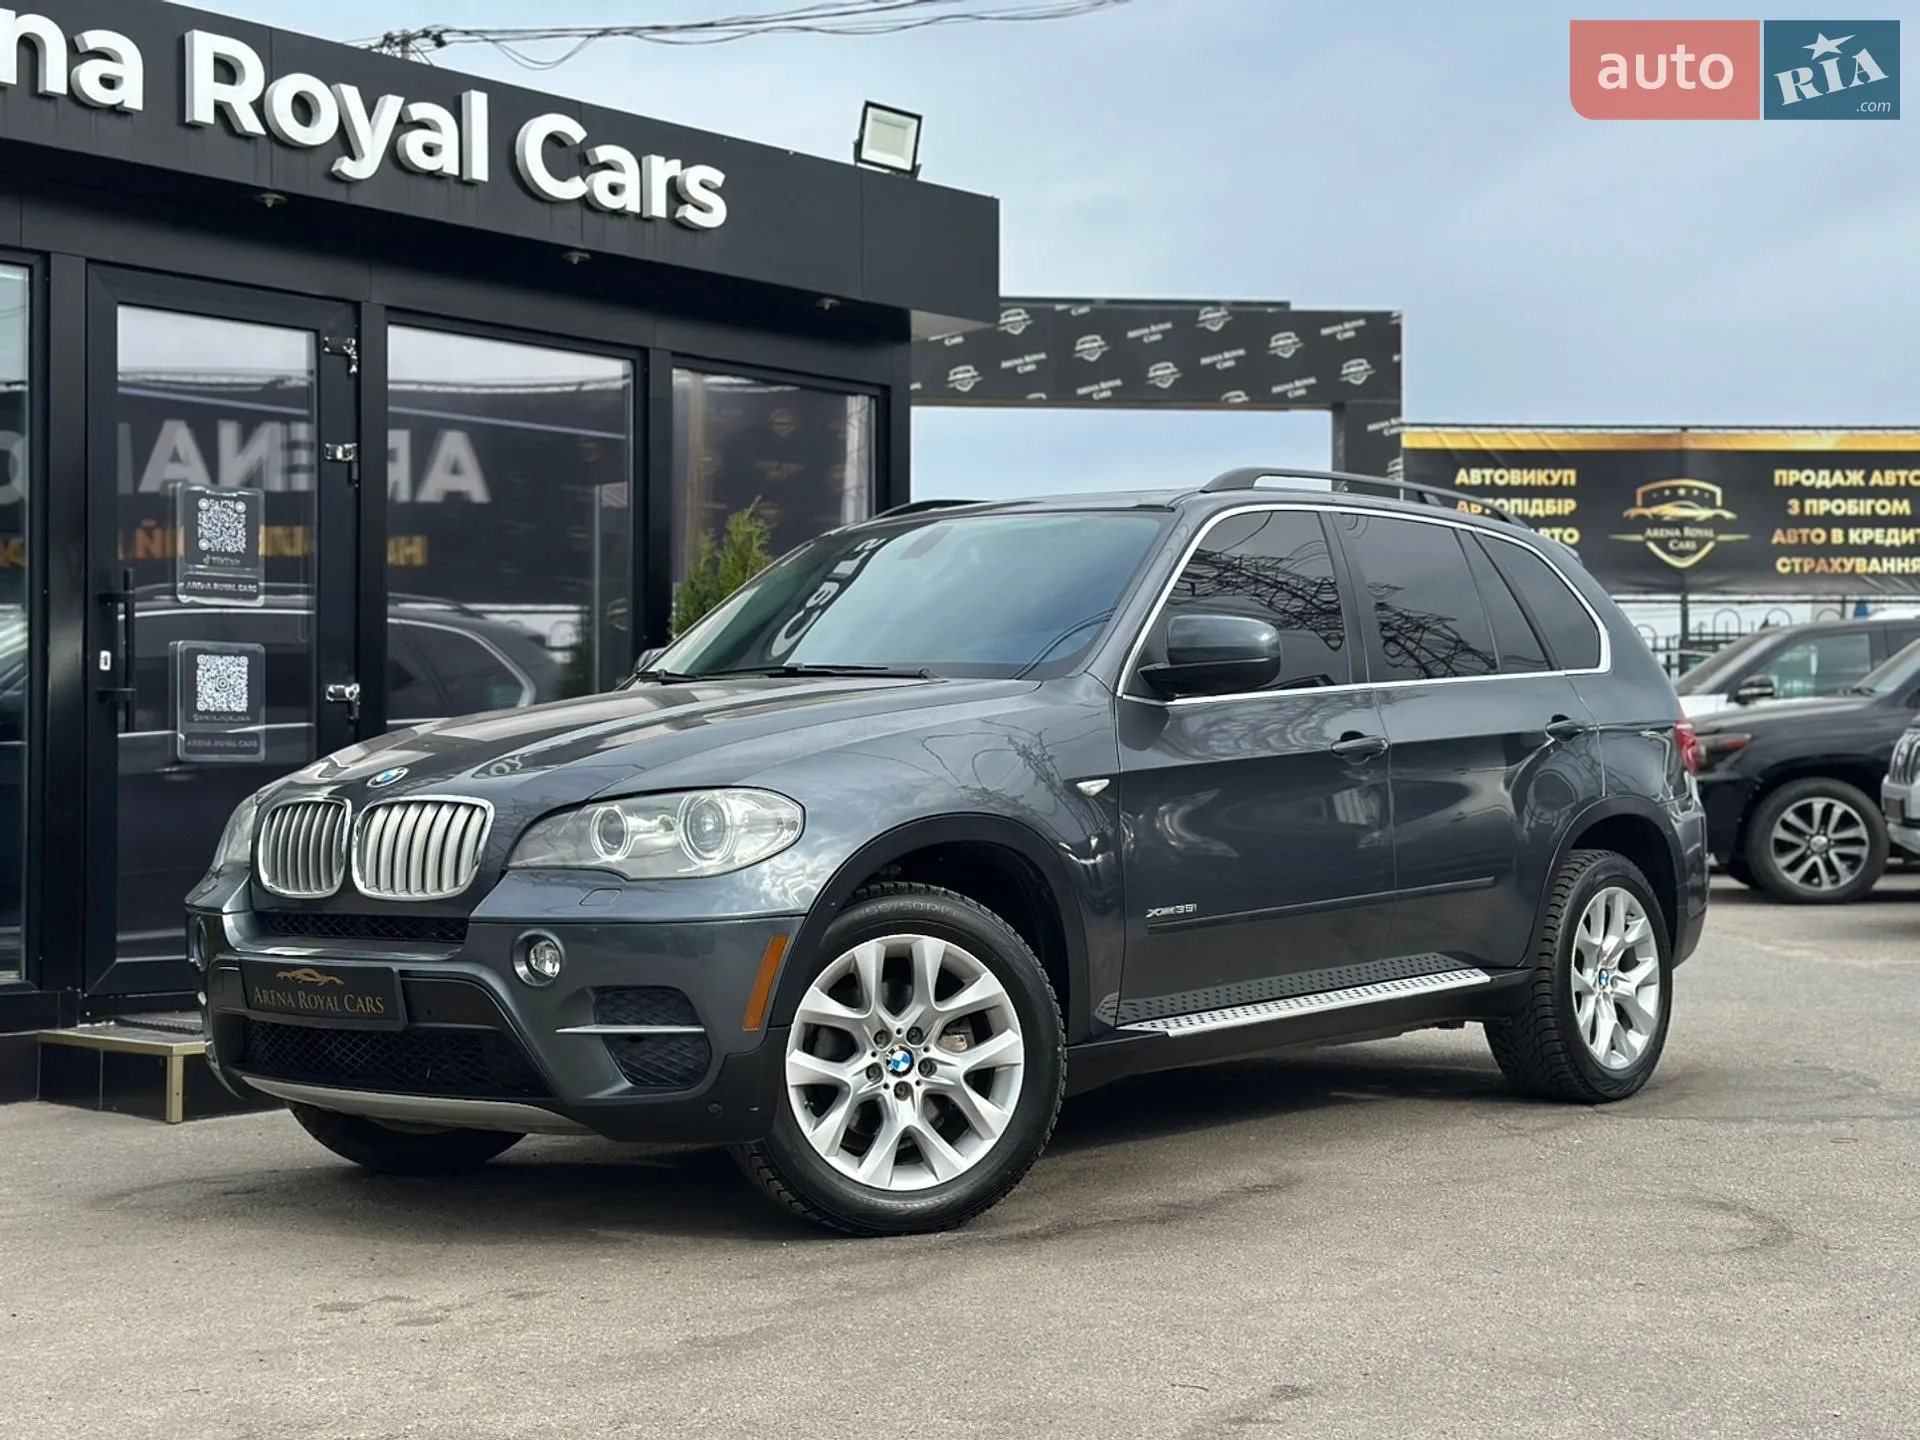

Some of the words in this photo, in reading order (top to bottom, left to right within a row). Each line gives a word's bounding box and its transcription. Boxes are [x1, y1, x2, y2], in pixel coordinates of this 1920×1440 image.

[184, 28, 491, 184] Royal
[515, 112, 728, 230] Cars
[1454, 467, 1577, 486] АВТОВИКУП
[1773, 468, 1866, 489] ПРОДАЖ
[1804, 497, 1912, 517] ПРОБІГОМ
[1771, 527, 1827, 545] АВТО
[1830, 527, 1844, 545] В
[254, 986, 296, 1008] ARENA
[297, 990, 342, 1012] ROYAL
[343, 993, 385, 1014] CARS
